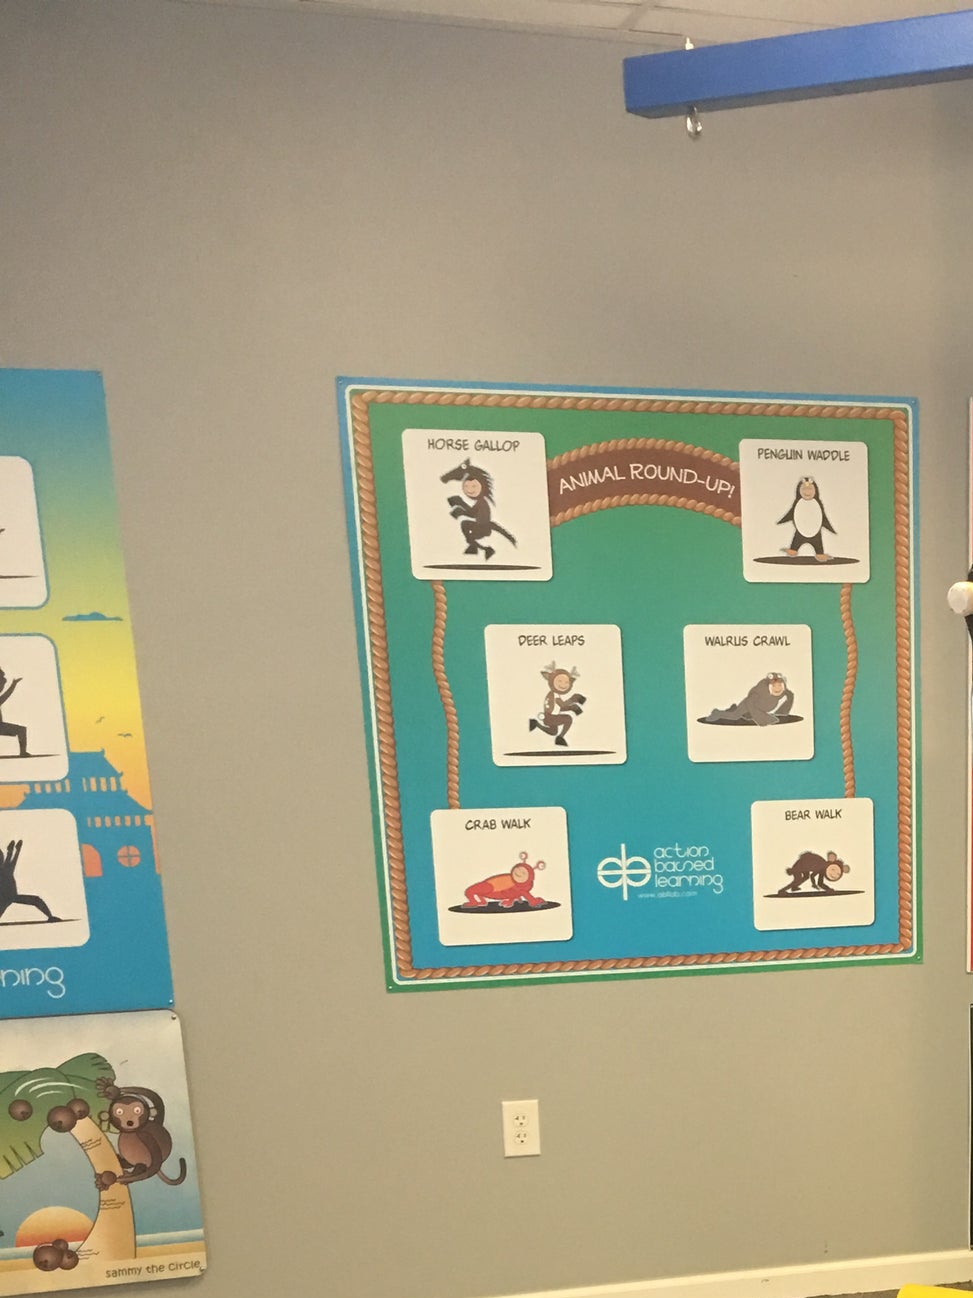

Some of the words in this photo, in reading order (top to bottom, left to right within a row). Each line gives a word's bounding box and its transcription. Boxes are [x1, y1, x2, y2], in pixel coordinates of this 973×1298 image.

[427, 438, 469, 451] HORSE
[474, 439, 520, 452] GALLOP
[757, 447, 803, 461] PENGUIN
[807, 449, 851, 461] WADDLE
[559, 465, 626, 495] ANIMAL
[629, 463, 736, 498] ROUND-UP!
[518, 635, 547, 646] DEER
[552, 634, 585, 646] LEAPS
[704, 635, 749, 647] WALRUS
[753, 635, 790, 647] CRAWL
[785, 809, 811, 820] BEAR
[815, 808, 842, 819] WALK
[465, 819, 497, 830] CRAB
[501, 818, 531, 829] WALK
[653, 842, 709, 858] action
[653, 857, 714, 873] based
[655, 874, 724, 894] learning
[0, 966, 66, 999] ning
[105, 1266, 142, 1279] sammy
[145, 1264, 165, 1274] the
